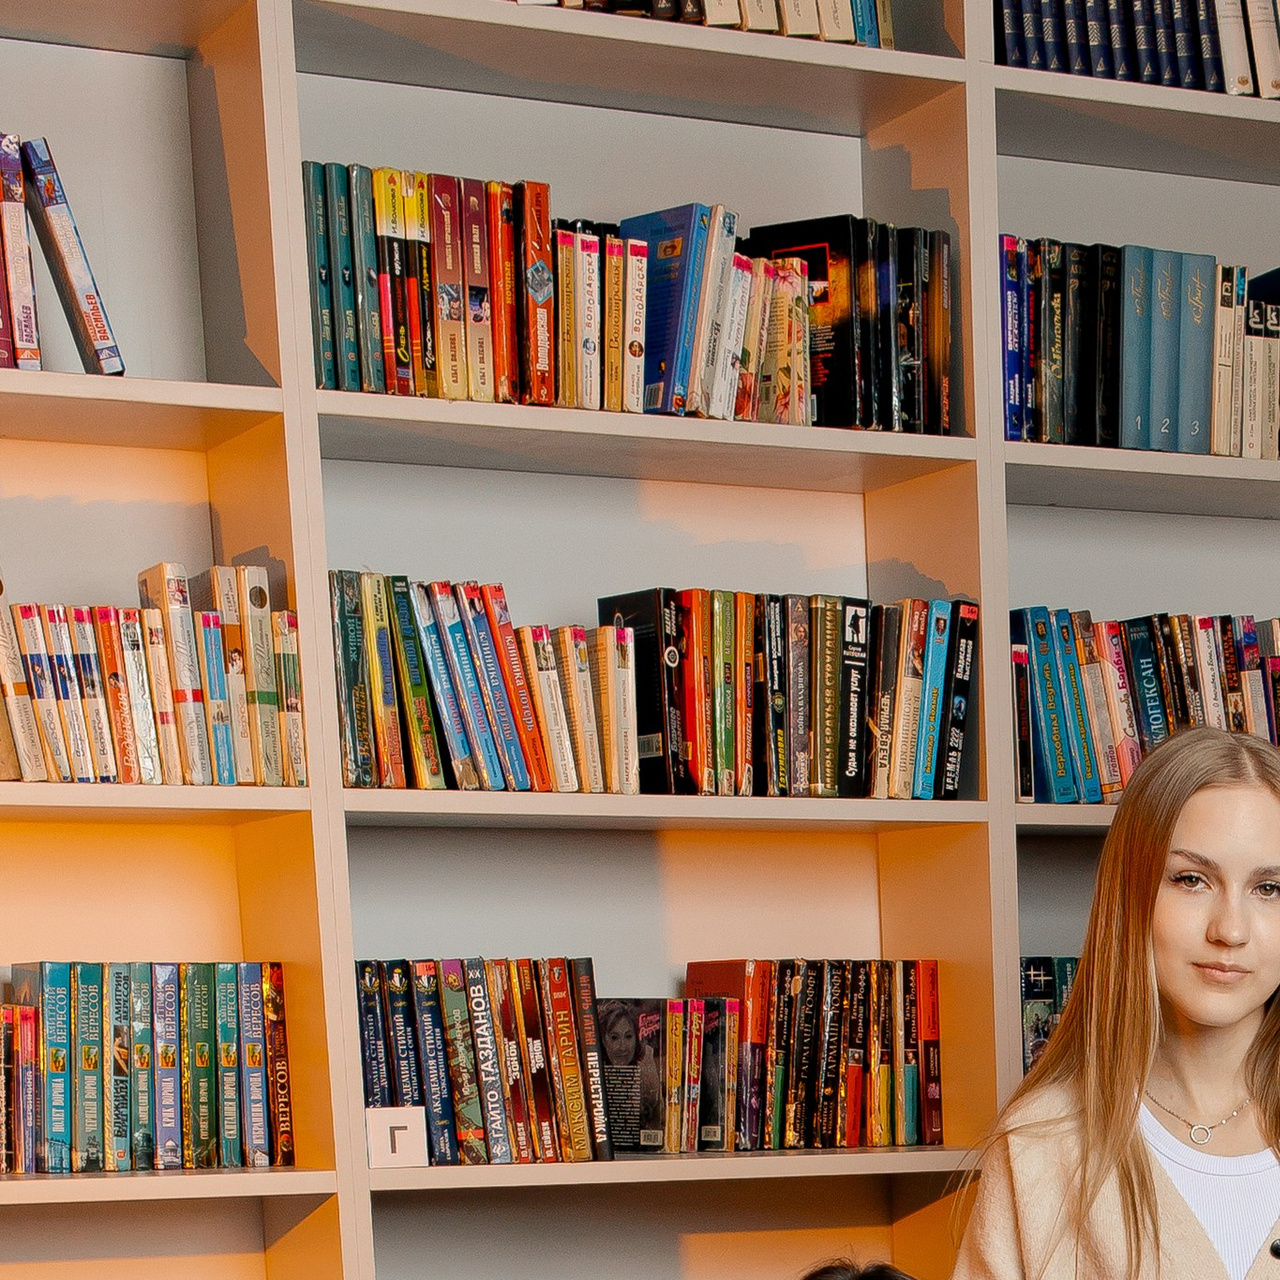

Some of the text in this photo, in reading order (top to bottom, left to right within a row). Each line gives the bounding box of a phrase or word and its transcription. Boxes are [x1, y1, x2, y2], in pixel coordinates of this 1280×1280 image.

[22, 305, 34, 344] ВАСИЛЬЕВ
[85, 294, 109, 341] ВАСИЛЬЕВ
[1161, 418, 1170, 433] 2
[1191, 421, 1200, 435] 3
[347, 618, 358, 662] ЖИВОЙ
[824, 601, 837, 789] МИРЫ БРАТЬЕВ СТРУГАЦКИХ
[846, 669, 859, 777] Судья не оказывает услуг
[949, 727, 960, 747] 2222
[879, 734, 890, 769] СВЕЧА
[57, 987, 67, 1043] ВЕРЕСОВ
[88, 985, 99, 1040] ВЕРЕСОВ
[165, 983, 176, 1039] ВЕРЕСОВ
[250, 983, 261, 1038] ВЕРЕСОВ
[395, 1014, 406, 1056] СТИХИЙ
[422, 1013, 434, 1056] СТИХИЙ
[469, 984, 504, 1138] ГАЙТО ГАЗДАНОВ
[556, 1010, 587, 1150] МАКСИМ ГАРИН
[276, 1061, 291, 1131] ВЕРЕСОВ
